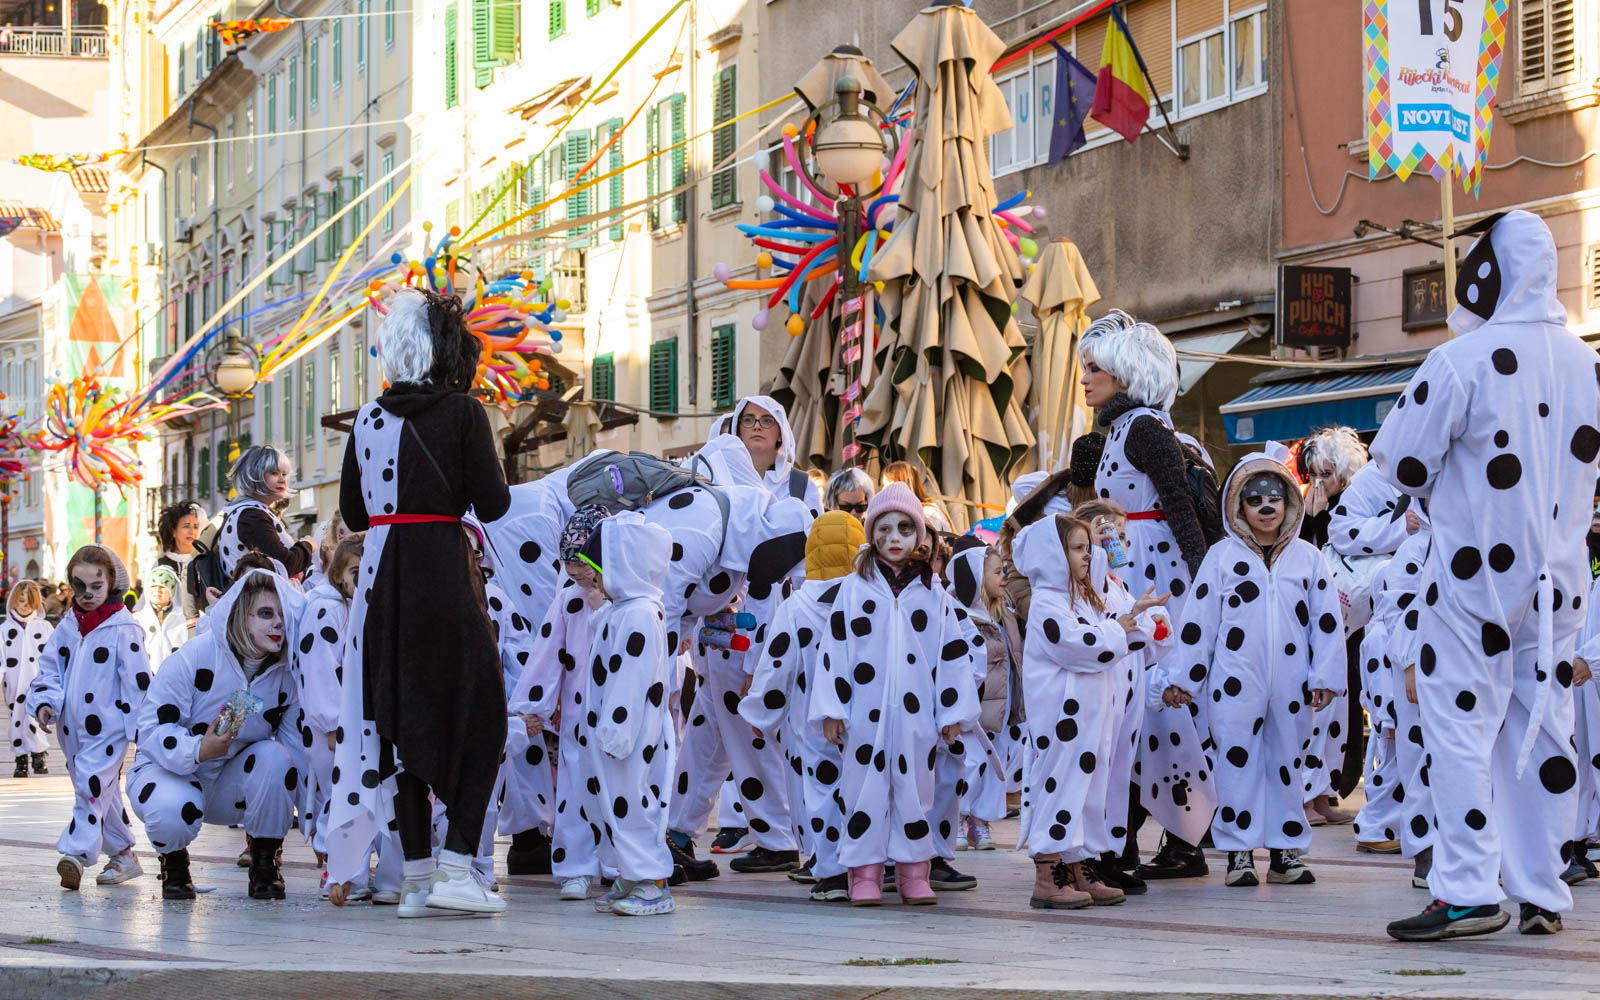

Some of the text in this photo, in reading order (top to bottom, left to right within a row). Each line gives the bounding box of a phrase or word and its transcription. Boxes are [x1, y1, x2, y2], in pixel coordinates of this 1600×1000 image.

[1006, 84, 1051, 123] UR
[1402, 110, 1469, 136] NOVI IST
[1301, 273, 1335, 297] HUG
[1289, 300, 1345, 328] PUNCH
